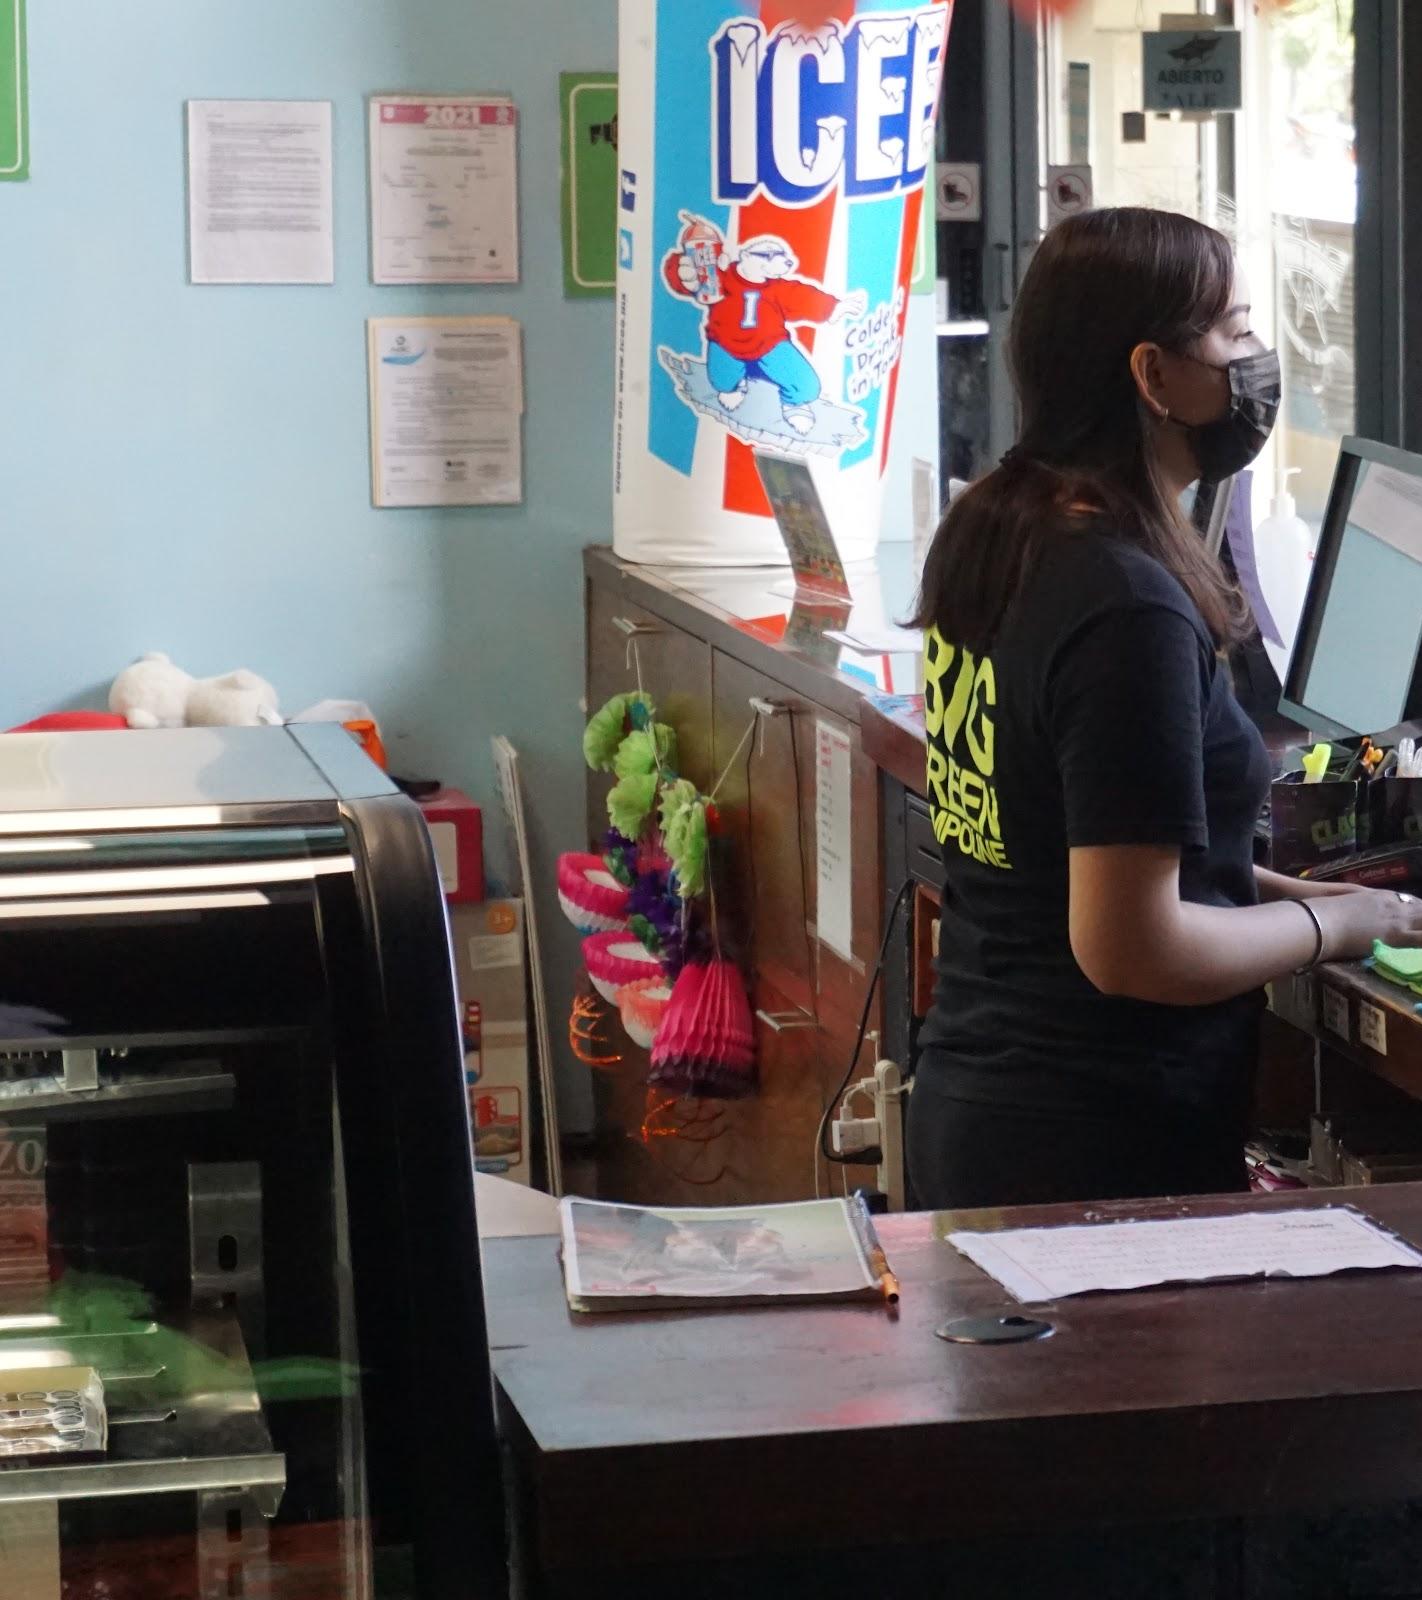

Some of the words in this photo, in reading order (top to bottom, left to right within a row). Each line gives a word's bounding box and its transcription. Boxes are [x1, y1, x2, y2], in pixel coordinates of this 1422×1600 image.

[1157, 69, 1224, 84] ABIERTO
[424, 105, 481, 129] 2021
[923, 622, 997, 777] BIG
